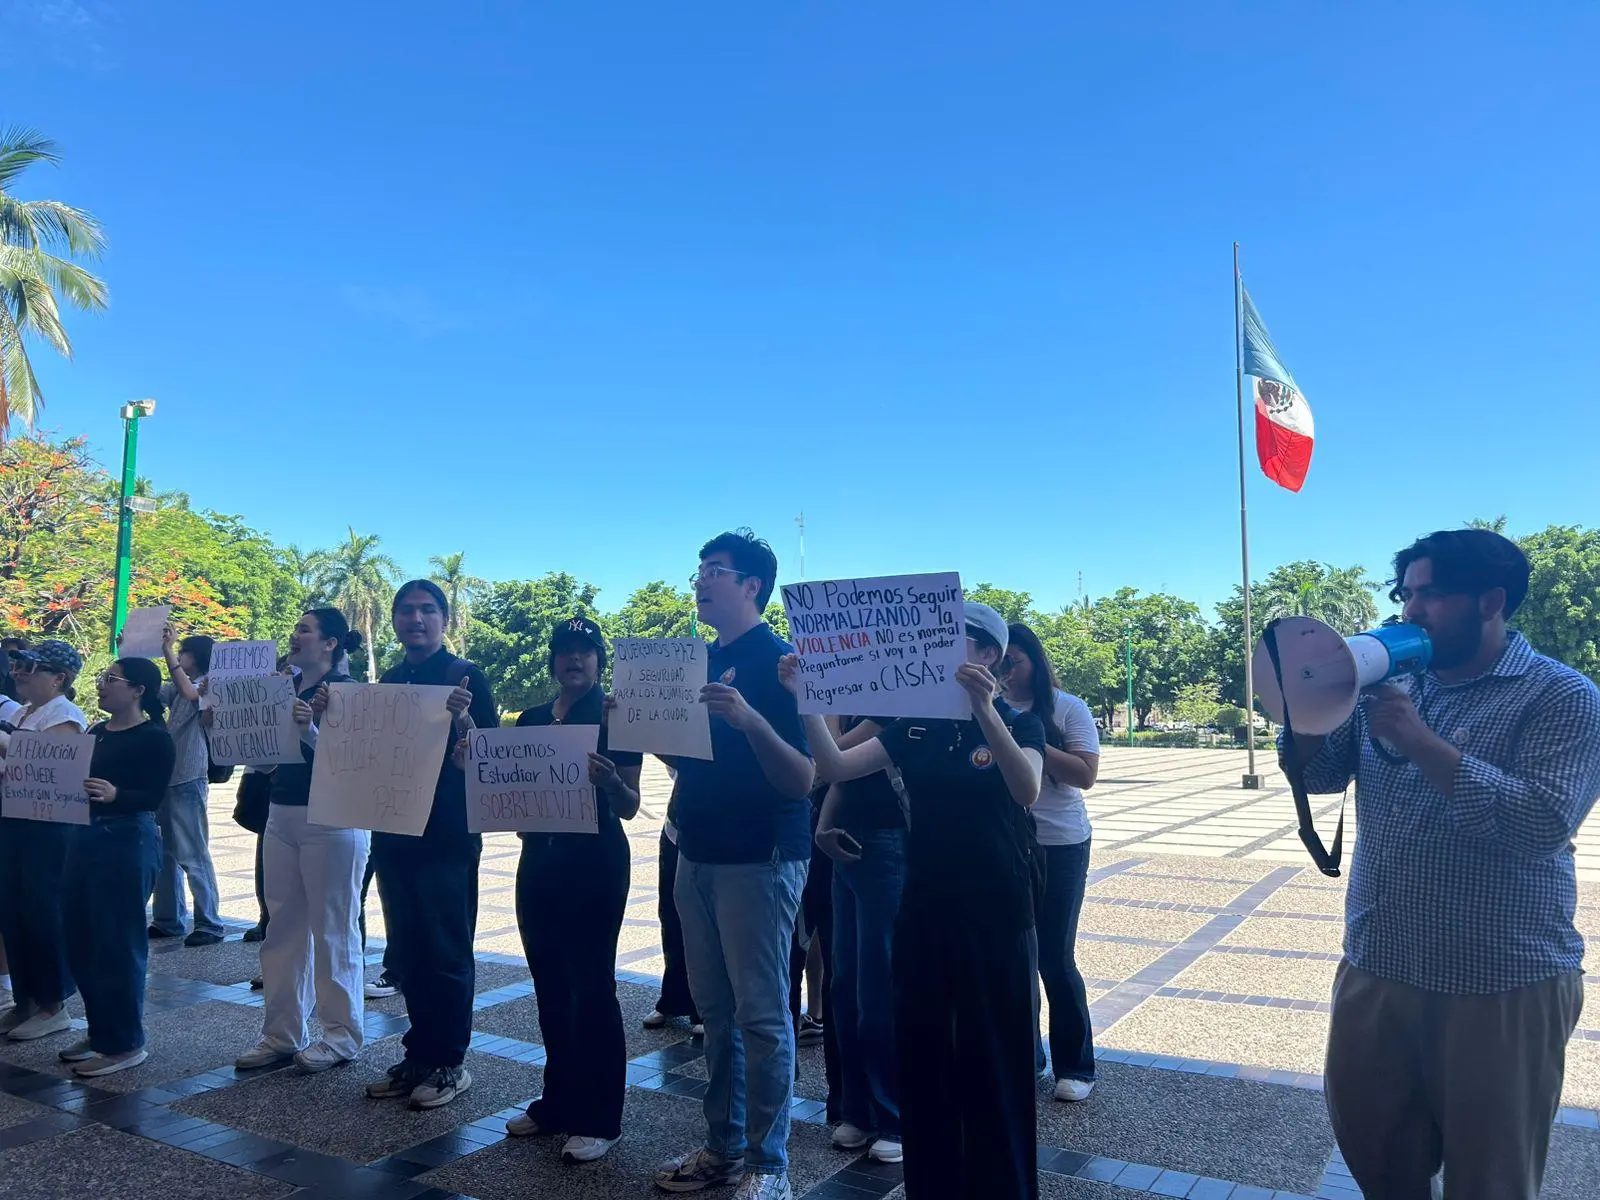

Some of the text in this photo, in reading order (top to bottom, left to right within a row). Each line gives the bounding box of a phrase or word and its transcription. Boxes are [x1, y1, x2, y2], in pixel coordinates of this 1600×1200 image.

[782, 580, 958, 614] NO Podemos Seguir
[568, 619, 584, 632] NY
[792, 605, 953, 635] NORMALIZANDO la
[795, 621, 960, 656] VIOLENCIA NO es normal
[211, 645, 269, 670] QUEREMOS
[672, 642, 697, 664] PAZ
[798, 653, 864, 679] Preguntarme
[884, 647, 904, 661] voy
[909, 646, 918, 655] a
[923, 638, 956, 658] poder
[639, 688, 655, 699] LOS
[805, 680, 863, 706] Regresar
[870, 681, 879, 692] a
[261, 703, 281, 727] QUE
[627, 707, 642, 723] DE
[648, 708, 660, 721] LA
[211, 735, 233, 758] NOS
[4, 765, 23, 781] NO
[478, 761, 580, 785] Estudiar NO
[36, 787, 51, 800] SIN
